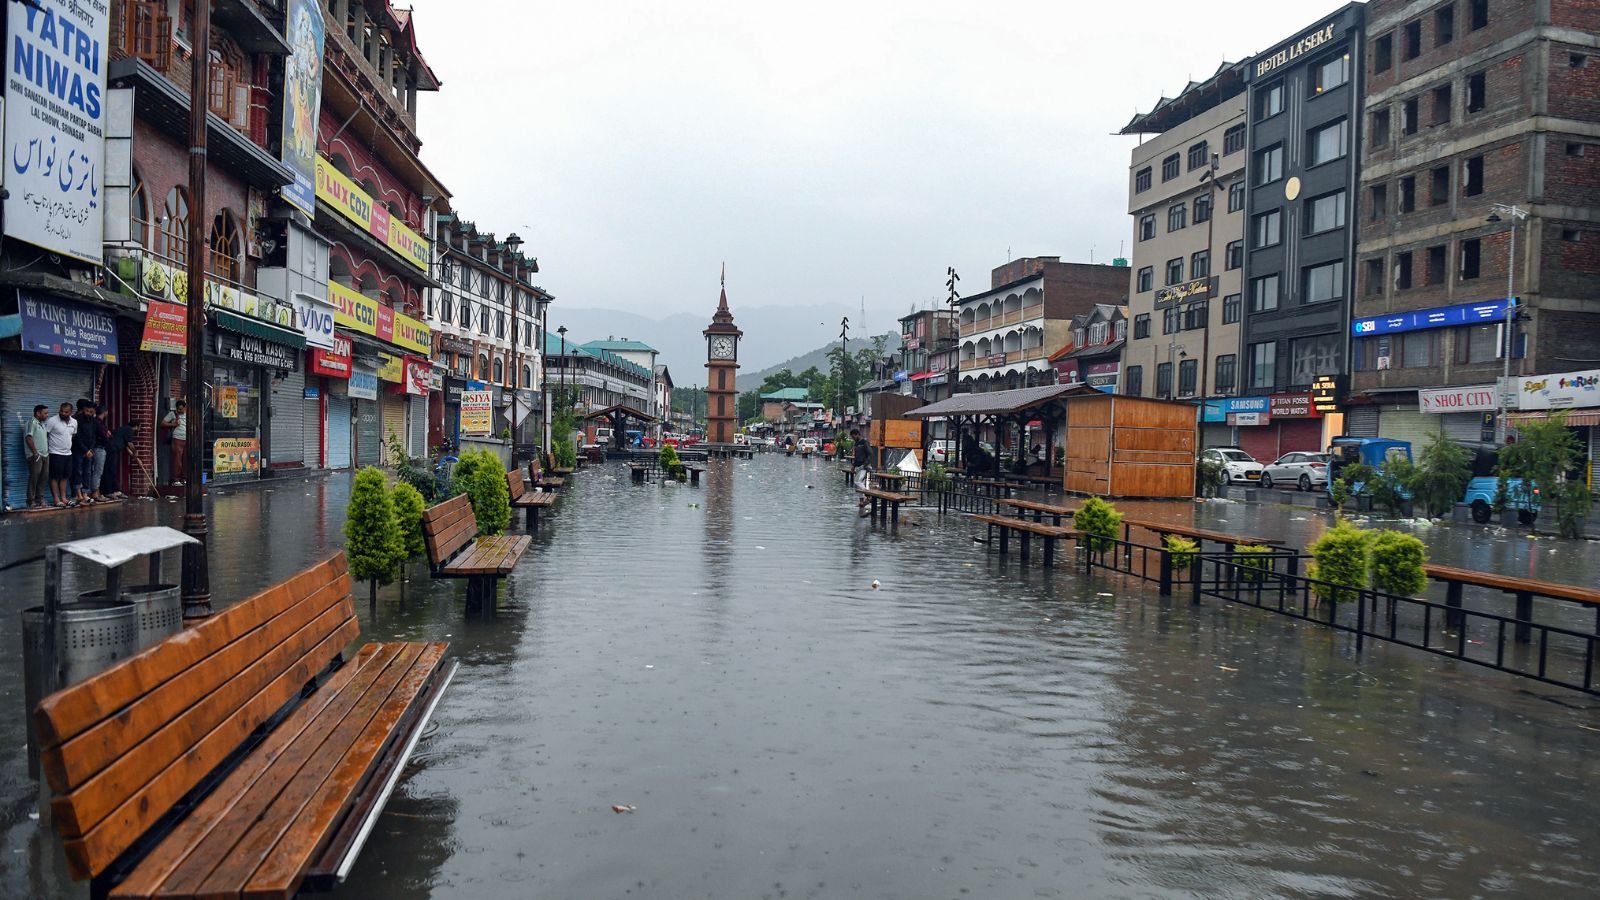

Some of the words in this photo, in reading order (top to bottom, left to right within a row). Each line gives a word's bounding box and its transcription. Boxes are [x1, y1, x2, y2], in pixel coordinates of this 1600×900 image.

[24, 0, 99, 76] YATRI
[1257, 50, 1289, 77] HOTEL
[14, 34, 100, 119] NIWAS
[10, 79, 23, 94] SHRI
[24, 87, 47, 108] SANATAN
[48, 101, 69, 120] DHARAM
[69, 113, 87, 128] PARTAP
[87, 122, 102, 138] SABHA
[31, 105, 40, 119] LAL
[61, 122, 85, 143] SRINAGAR
[326, 174, 348, 206] LUX
[349, 191, 370, 224] COZI
[397, 230, 412, 254] LUX
[413, 241, 428, 264] COZI
[40, 303, 67, 325] KING
[72, 310, 113, 333] MOBILES
[331, 293, 354, 318] LUX
[355, 302, 375, 327] COZI
[79, 329, 106, 345] Repairing
[401, 323, 415, 342] LUX
[415, 328, 429, 346] COZI
[1362, 320, 1375, 332] SBI
[241, 336, 262, 354] ROYAL
[266, 342, 286, 358] RASOI
[230, 348, 242, 360] PURE
[244, 351, 253, 362] VEG
[254, 353, 280, 367] RESTAURANT
[284, 360, 294, 369] CAFE
[1092, 378, 1109, 386] SONY
[470, 393, 490, 402] SIYA
[1231, 400, 1264, 409] SAMSUNG
[1292, 397, 1309, 405] FOSSIL
[1435, 393, 1463, 407] SHOE
[1466, 391, 1492, 406] CITY
[1485, 414, 1492, 424] P
